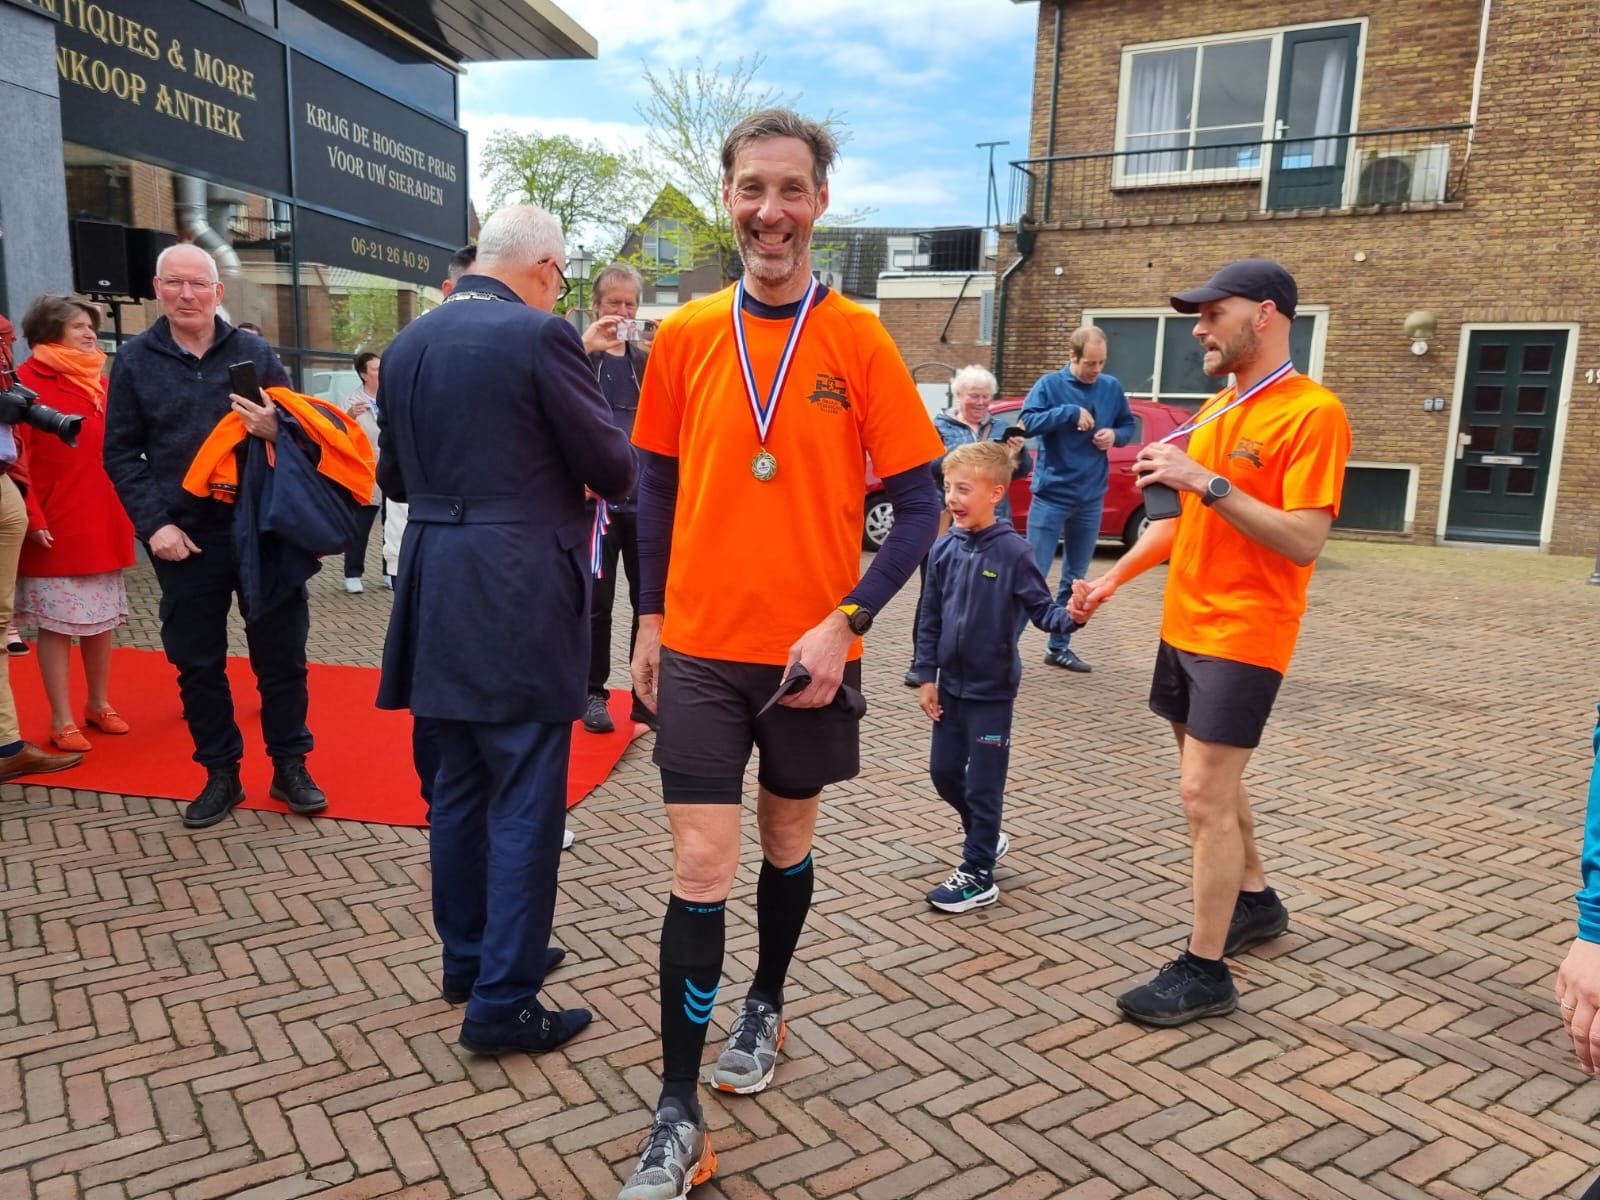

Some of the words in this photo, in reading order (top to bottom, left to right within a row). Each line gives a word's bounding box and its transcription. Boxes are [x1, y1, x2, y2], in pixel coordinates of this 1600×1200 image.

[167, 39, 187, 73] &
[193, 48, 257, 101] MORE
[155, 83, 245, 141] ANTIEK
[306, 102, 350, 141] KRIJG
[352, 122, 370, 149] DE
[373, 131, 426, 171] HOOGSTE
[428, 155, 457, 183] PRIJS
[327, 145, 365, 179] VOOR
[367, 160, 387, 185] UW
[388, 169, 444, 206] SIERADEN
[351, 236, 383, 260] 06-21
[386, 246, 400, 265] 26
[402, 250, 416, 268] 40
[417, 254, 430, 273] 29
